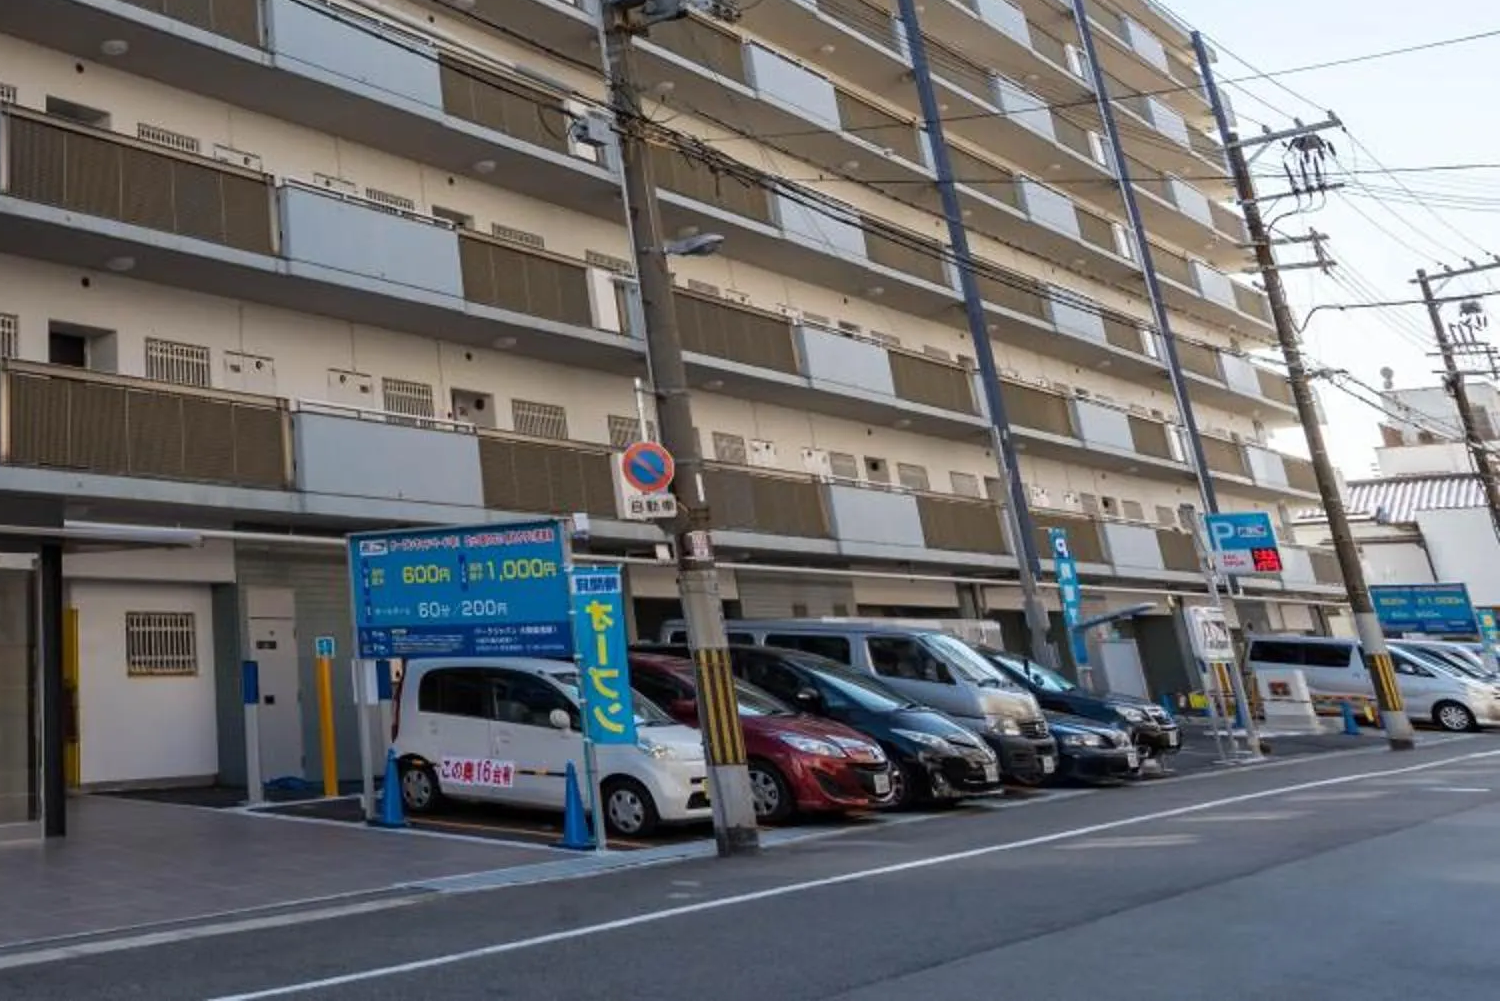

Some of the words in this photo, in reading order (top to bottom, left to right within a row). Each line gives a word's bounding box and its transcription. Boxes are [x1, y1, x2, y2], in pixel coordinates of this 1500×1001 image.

[631, 498, 675, 514] 自動車
[1211, 522, 1235, 552] P
[403, 565, 450, 584] 600円
[486, 558, 557, 582] 1,000円
